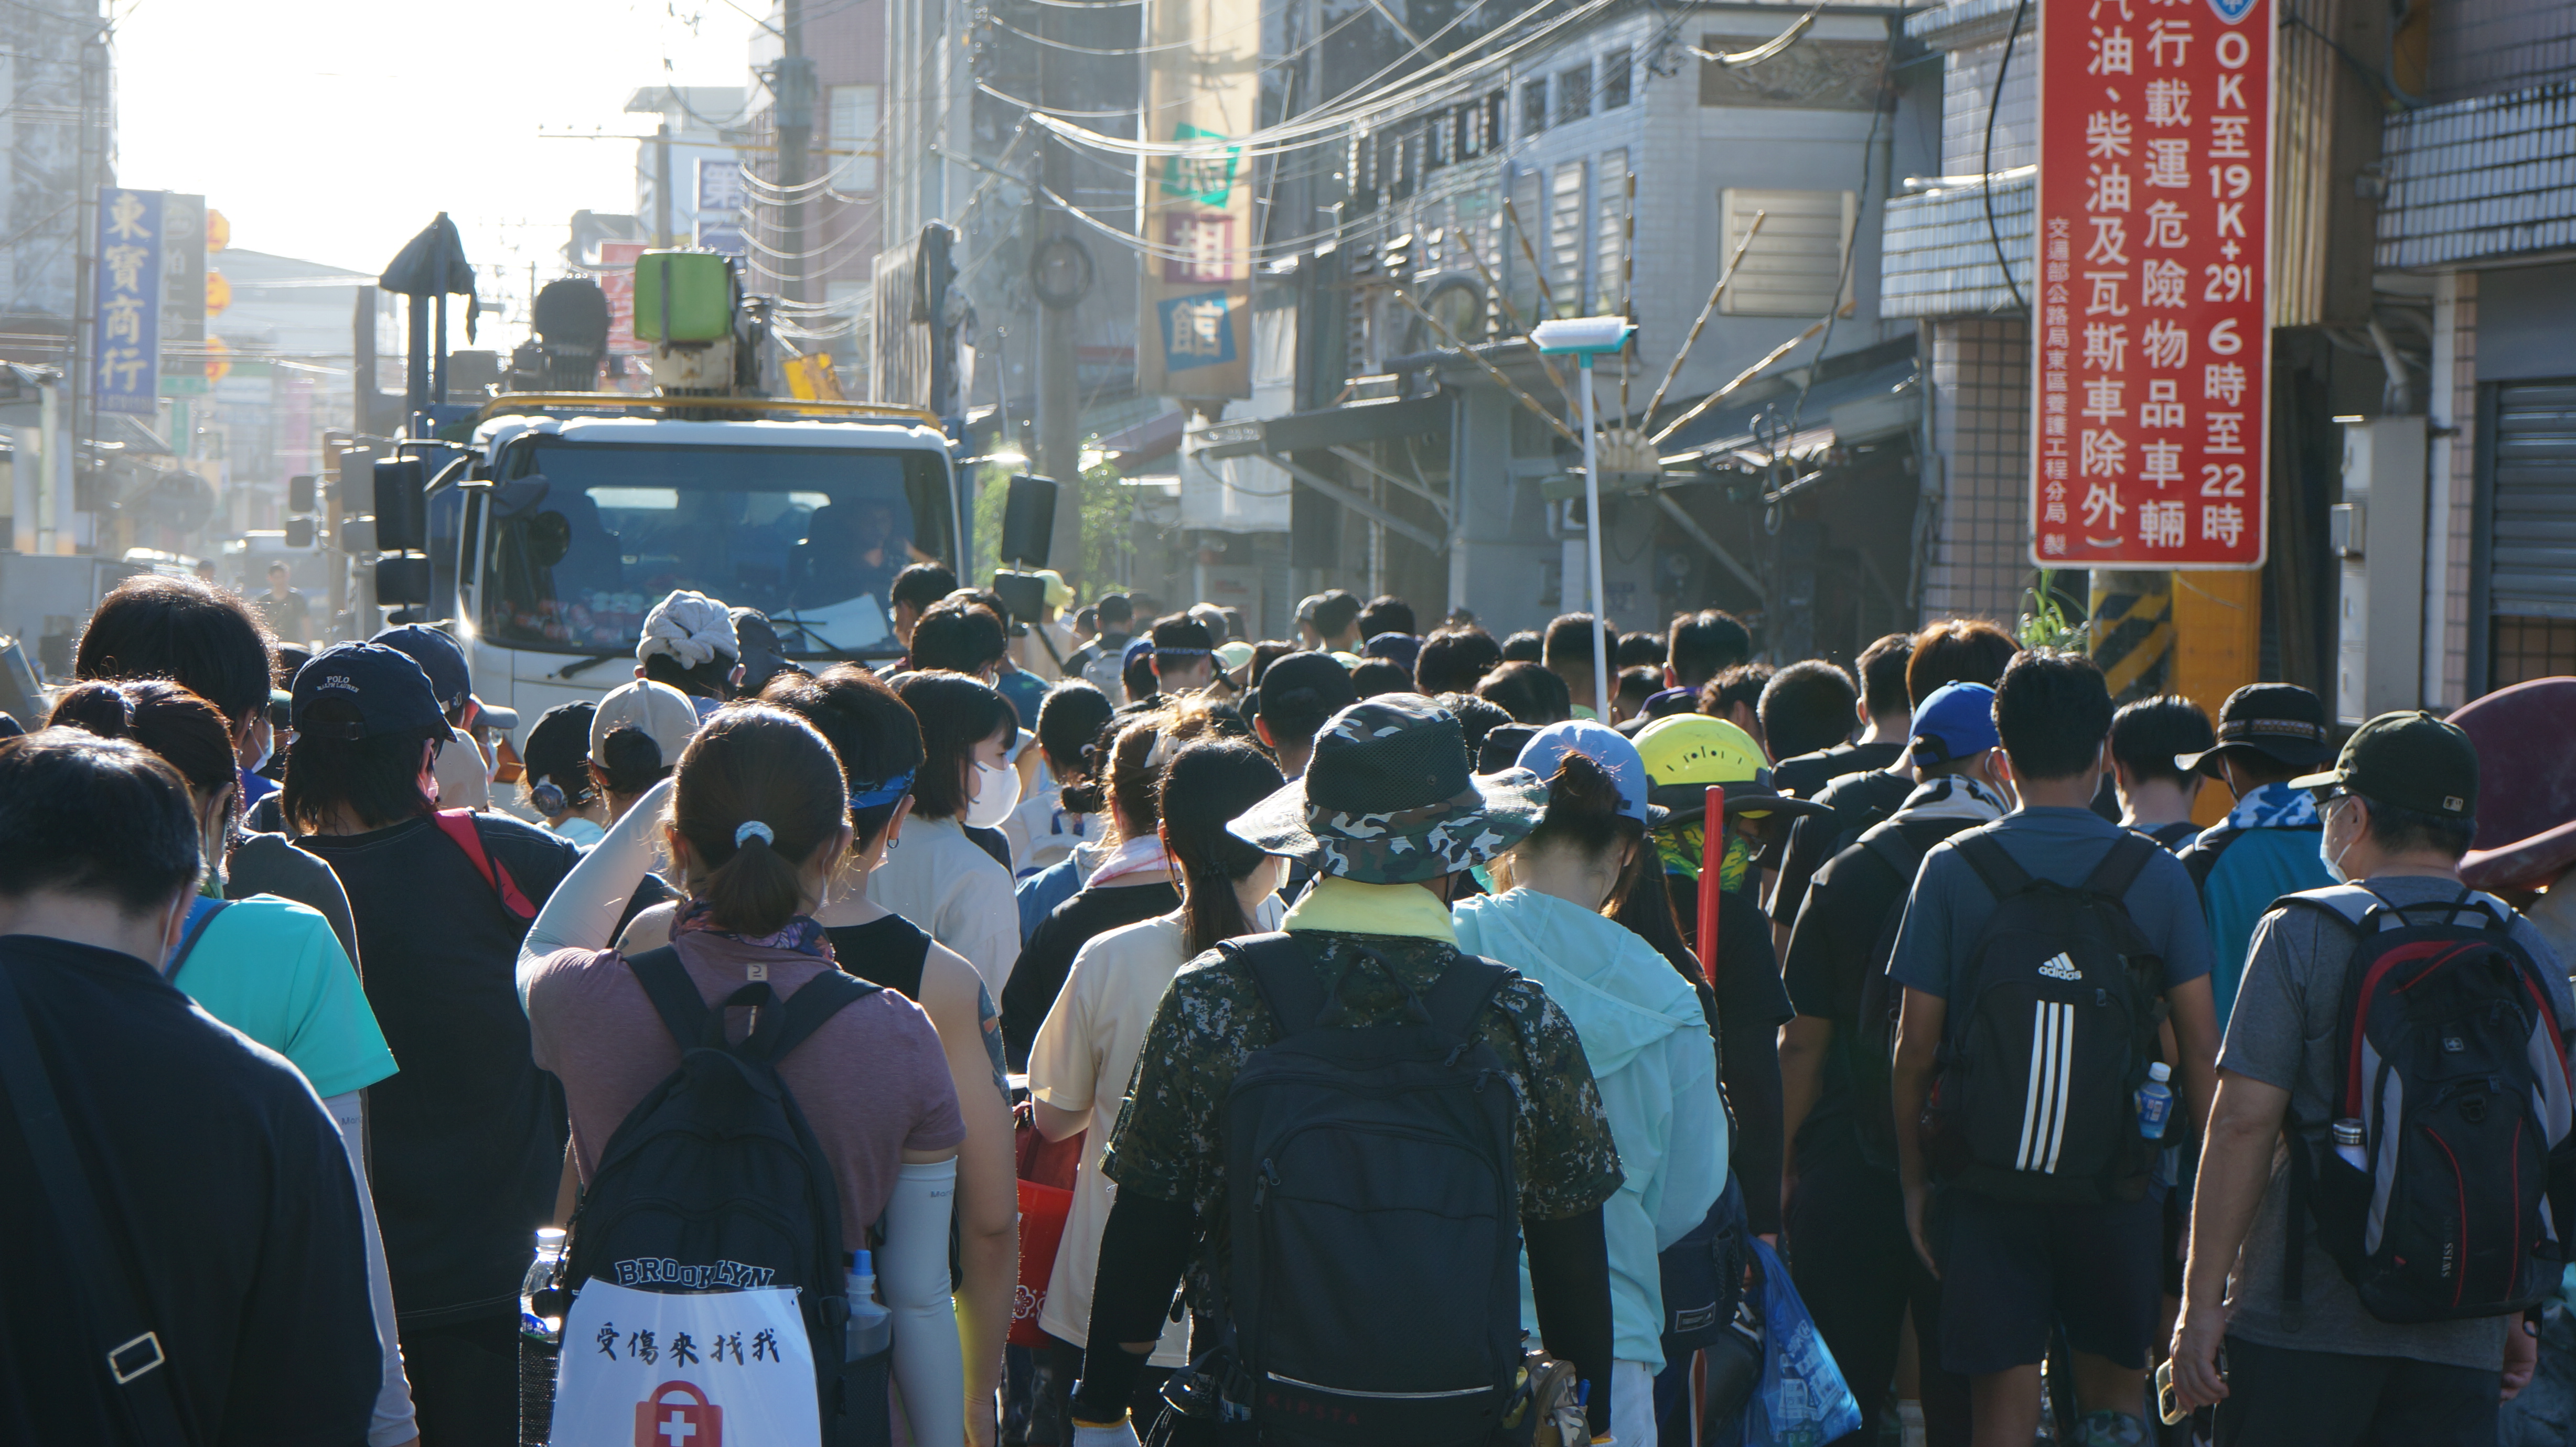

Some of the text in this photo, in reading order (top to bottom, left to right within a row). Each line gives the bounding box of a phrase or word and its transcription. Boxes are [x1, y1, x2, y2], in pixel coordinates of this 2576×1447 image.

[99, 190, 153, 393] 東寶商行
[2138, 0, 2193, 548] 行載運危險物品車輛
[316, 683, 360, 693] RALPH LAUREN
[2038, 965, 2083, 981] adidas
[614, 1257, 776, 1290] BROOKLYN
[596, 1321, 781, 1368] 受傷來找我
